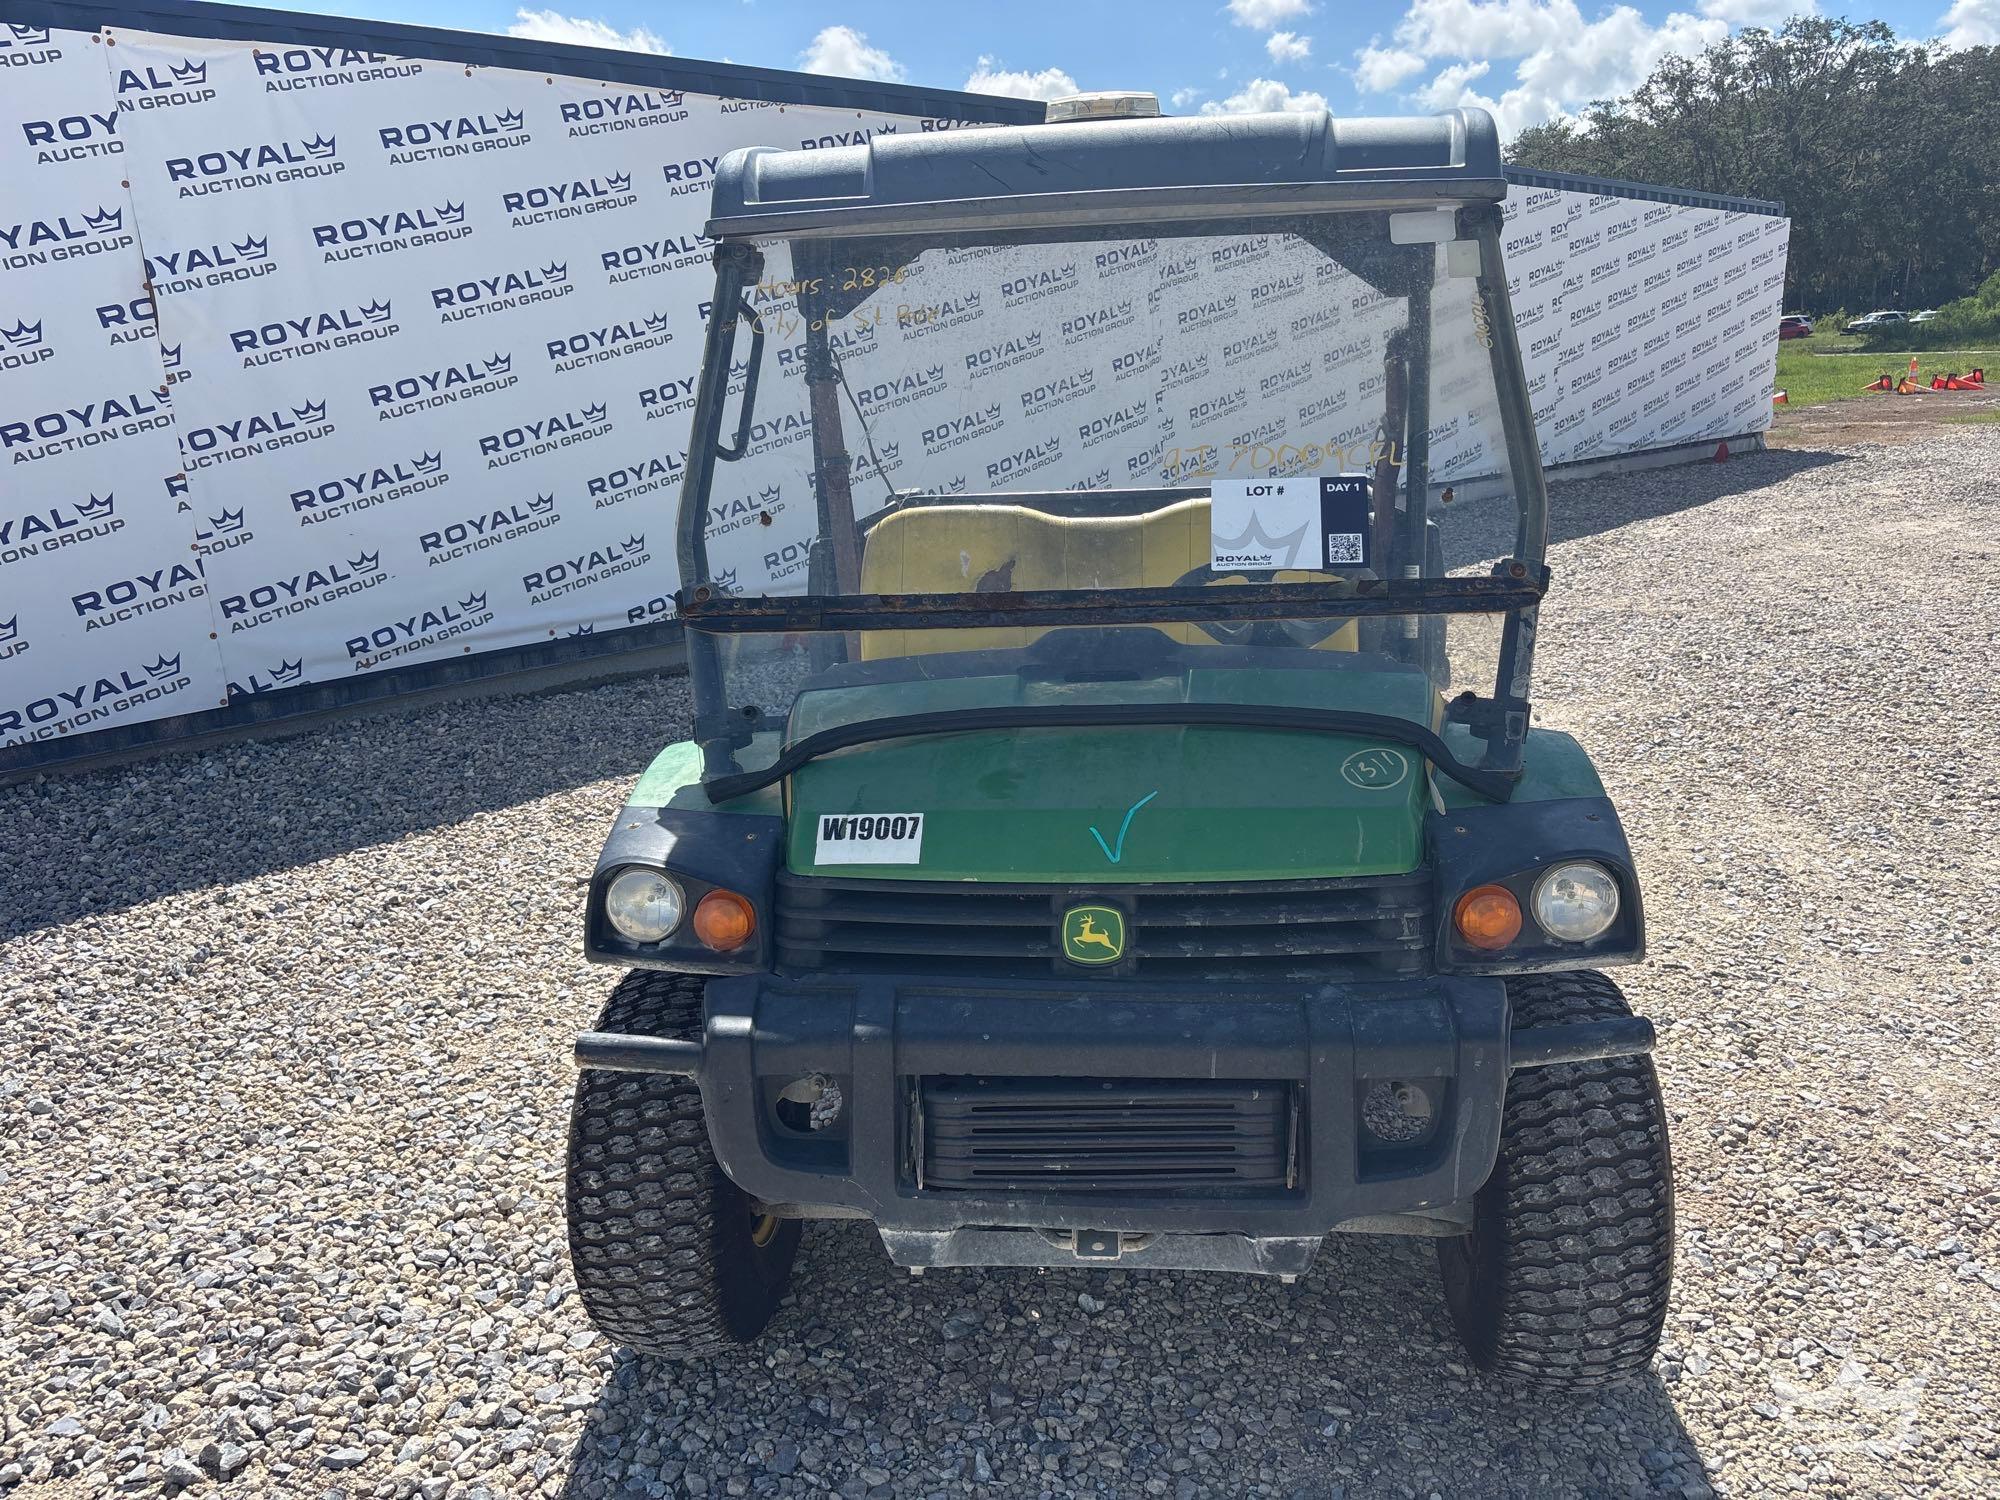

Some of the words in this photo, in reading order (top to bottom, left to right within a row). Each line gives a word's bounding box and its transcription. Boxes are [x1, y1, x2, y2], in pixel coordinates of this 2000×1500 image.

[266, 71, 354, 93] AUCTION
[357, 64, 423, 82] GROUP
[139, 89, 216, 109] GROUP
[560, 92, 661, 123] ROYAL
[379, 116, 498, 148] ROYAL
[568, 118, 636, 138] AUCTION
[639, 110, 689, 127] GROUP
[165, 142, 305, 182] ROYAL
[389, 143, 469, 165] AUCTION
[472, 134, 531, 153] GROUP
[179, 172, 272, 199] AUCTION
[276, 161, 346, 183] GROUP
[502, 179, 608, 213] ROYAL
[512, 206, 583, 228] AUCTION
[584, 195, 637, 214] GROUP
[1527, 190, 1554, 206] ROYAL
[312, 209, 438, 247] ROYAL
[1608, 221, 1631, 236] ROYAL
[1644, 206, 1666, 221] ROYAL
[51, 235, 134, 260] GROUP
[324, 240, 408, 263] AUCTION
[410, 226, 473, 247] GROUP
[601, 235, 696, 271] ROYAL
[948, 248, 990, 266] AUCTION
[1096, 242, 1149, 269] ROYAL
[1212, 240, 1257, 264] ROYAL
[1507, 235, 1534, 252] ROYAL
[1570, 234, 1595, 251] ROYAL
[1627, 246, 1650, 262] ROYAL
[1708, 243, 1728, 258] ROYAL
[207, 262, 278, 286] GROUP
[608, 264, 673, 284] AUCTION
[1099, 261, 1135, 279] AUCTION
[1214, 258, 1245, 273] AUCTION
[1246, 251, 1270, 264] GROUP
[1529, 263, 1556, 281] ROYAL
[1677, 256, 1697, 272] ROYAL
[431, 270, 544, 309] ROYAL
[1001, 268, 1062, 297] ROYAL
[1005, 290, 1046, 309] AUCTION
[1047, 280, 1079, 296] GROUP
[1251, 277, 1294, 300] ROYAL
[441, 298, 516, 324] AUCTION
[518, 284, 574, 306] GROUP
[1178, 300, 1225, 325] ROYAL
[1571, 304, 1595, 321] ROYAL
[1628, 312, 1651, 327] ROYAL
[230, 309, 362, 352] ROYAL
[752, 310, 799, 340] City
[811, 309, 835, 331] of
[903, 319, 948, 342] AUCTION
[950, 309, 984, 328] GROUP
[1062, 307, 1119, 336] ROYAL
[1065, 327, 1104, 346] AUCTION
[1105, 316, 1135, 332] GROUP
[1180, 319, 1212, 335] AUCTION
[1213, 309, 1238, 323] GROUP
[1291, 310, 1332, 333] ROYAL
[1675, 319, 1696, 334] ROYAL
[243, 339, 331, 369] AUCTION
[334, 324, 400, 348] GROUP
[546, 321, 645, 360] ROYAL
[554, 349, 621, 373] AUCTION
[623, 334, 673, 355] GROUP
[965, 339, 1026, 370] ROYAL
[1223, 333, 1268, 358] ROYAL
[1324, 341, 1363, 364] ROYAL
[1530, 334, 1557, 352] ROYAL
[969, 359, 1011, 381] AUCTION
[1012, 348, 1045, 366] GROUP
[1260, 368, 1302, 391] ROYAL
[1571, 371, 1596, 389] ROYAL
[368, 363, 486, 406] ROYAL
[379, 392, 457, 421] AUCTION
[460, 376, 519, 399] GROUP
[857, 372, 928, 406] ROYAL
[863, 394, 911, 418] AUCTION
[912, 382, 948, 401] GROUP
[1021, 376, 1079, 407] ROYAL
[1025, 398, 1063, 418] AUCTION
[1065, 385, 1096, 402] GROUP
[1189, 393, 1235, 420] ROYAL
[1191, 412, 1223, 430] AUCTION
[1224, 401, 1248, 418] GROUP
[1299, 396, 1338, 420] ROYAL
[0, 394, 155, 447] ROYAL
[479, 412, 583, 455] ROYAL
[922, 411, 987, 445] ROYAL
[1079, 405, 1134, 440] ROYAL
[1082, 425, 1120, 449] AUCTION
[1121, 416, 1149, 433] GROUP
[1609, 415, 1632, 432] ROYAL
[13, 428, 118, 464] AUCTION
[266, 424, 335, 451] GROUP
[487, 440, 558, 470] AUCTION
[561, 423, 613, 446] GROUP
[926, 433, 969, 456] AUCTION
[971, 420, 1005, 439] GROUP
[587, 454, 682, 496] ROYAL
[987, 445, 1046, 478] ROYAL
[991, 466, 1031, 488] AUCTION
[1032, 452, 1063, 471] GROUP
[290, 463, 415, 512] ROYAL
[301, 494, 385, 526] AUCTION
[387, 474, 449, 501] GROUP
[595, 481, 659, 509] AUCTION
[1246, 486, 1273, 496] LOT
[1277, 486, 1284, 496] #
[1326, 483, 1351, 492] DAY
[1354, 483, 1360, 492] 1
[42, 519, 125, 551] GROUP
[419, 505, 530, 553] ROYAL
[429, 534, 503, 567] AUCTION
[505, 514, 561, 540] GROUP
[522, 546, 623, 592] ROYAL
[531, 573, 598, 605] AUCTION
[600, 554, 651, 579] GROUP
[220, 564, 351, 618] ROYAL
[231, 595, 320, 633] AUCTION
[322, 572, 387, 603] GROUP
[86, 592, 185, 632] AUCTION
[346, 606, 461, 657] ROYAL
[355, 634, 435, 671] AUCTION
[437, 612, 494, 641] GROUP
[115, 676, 191, 712] GROUP
[822, 816, 920, 841] W19007
